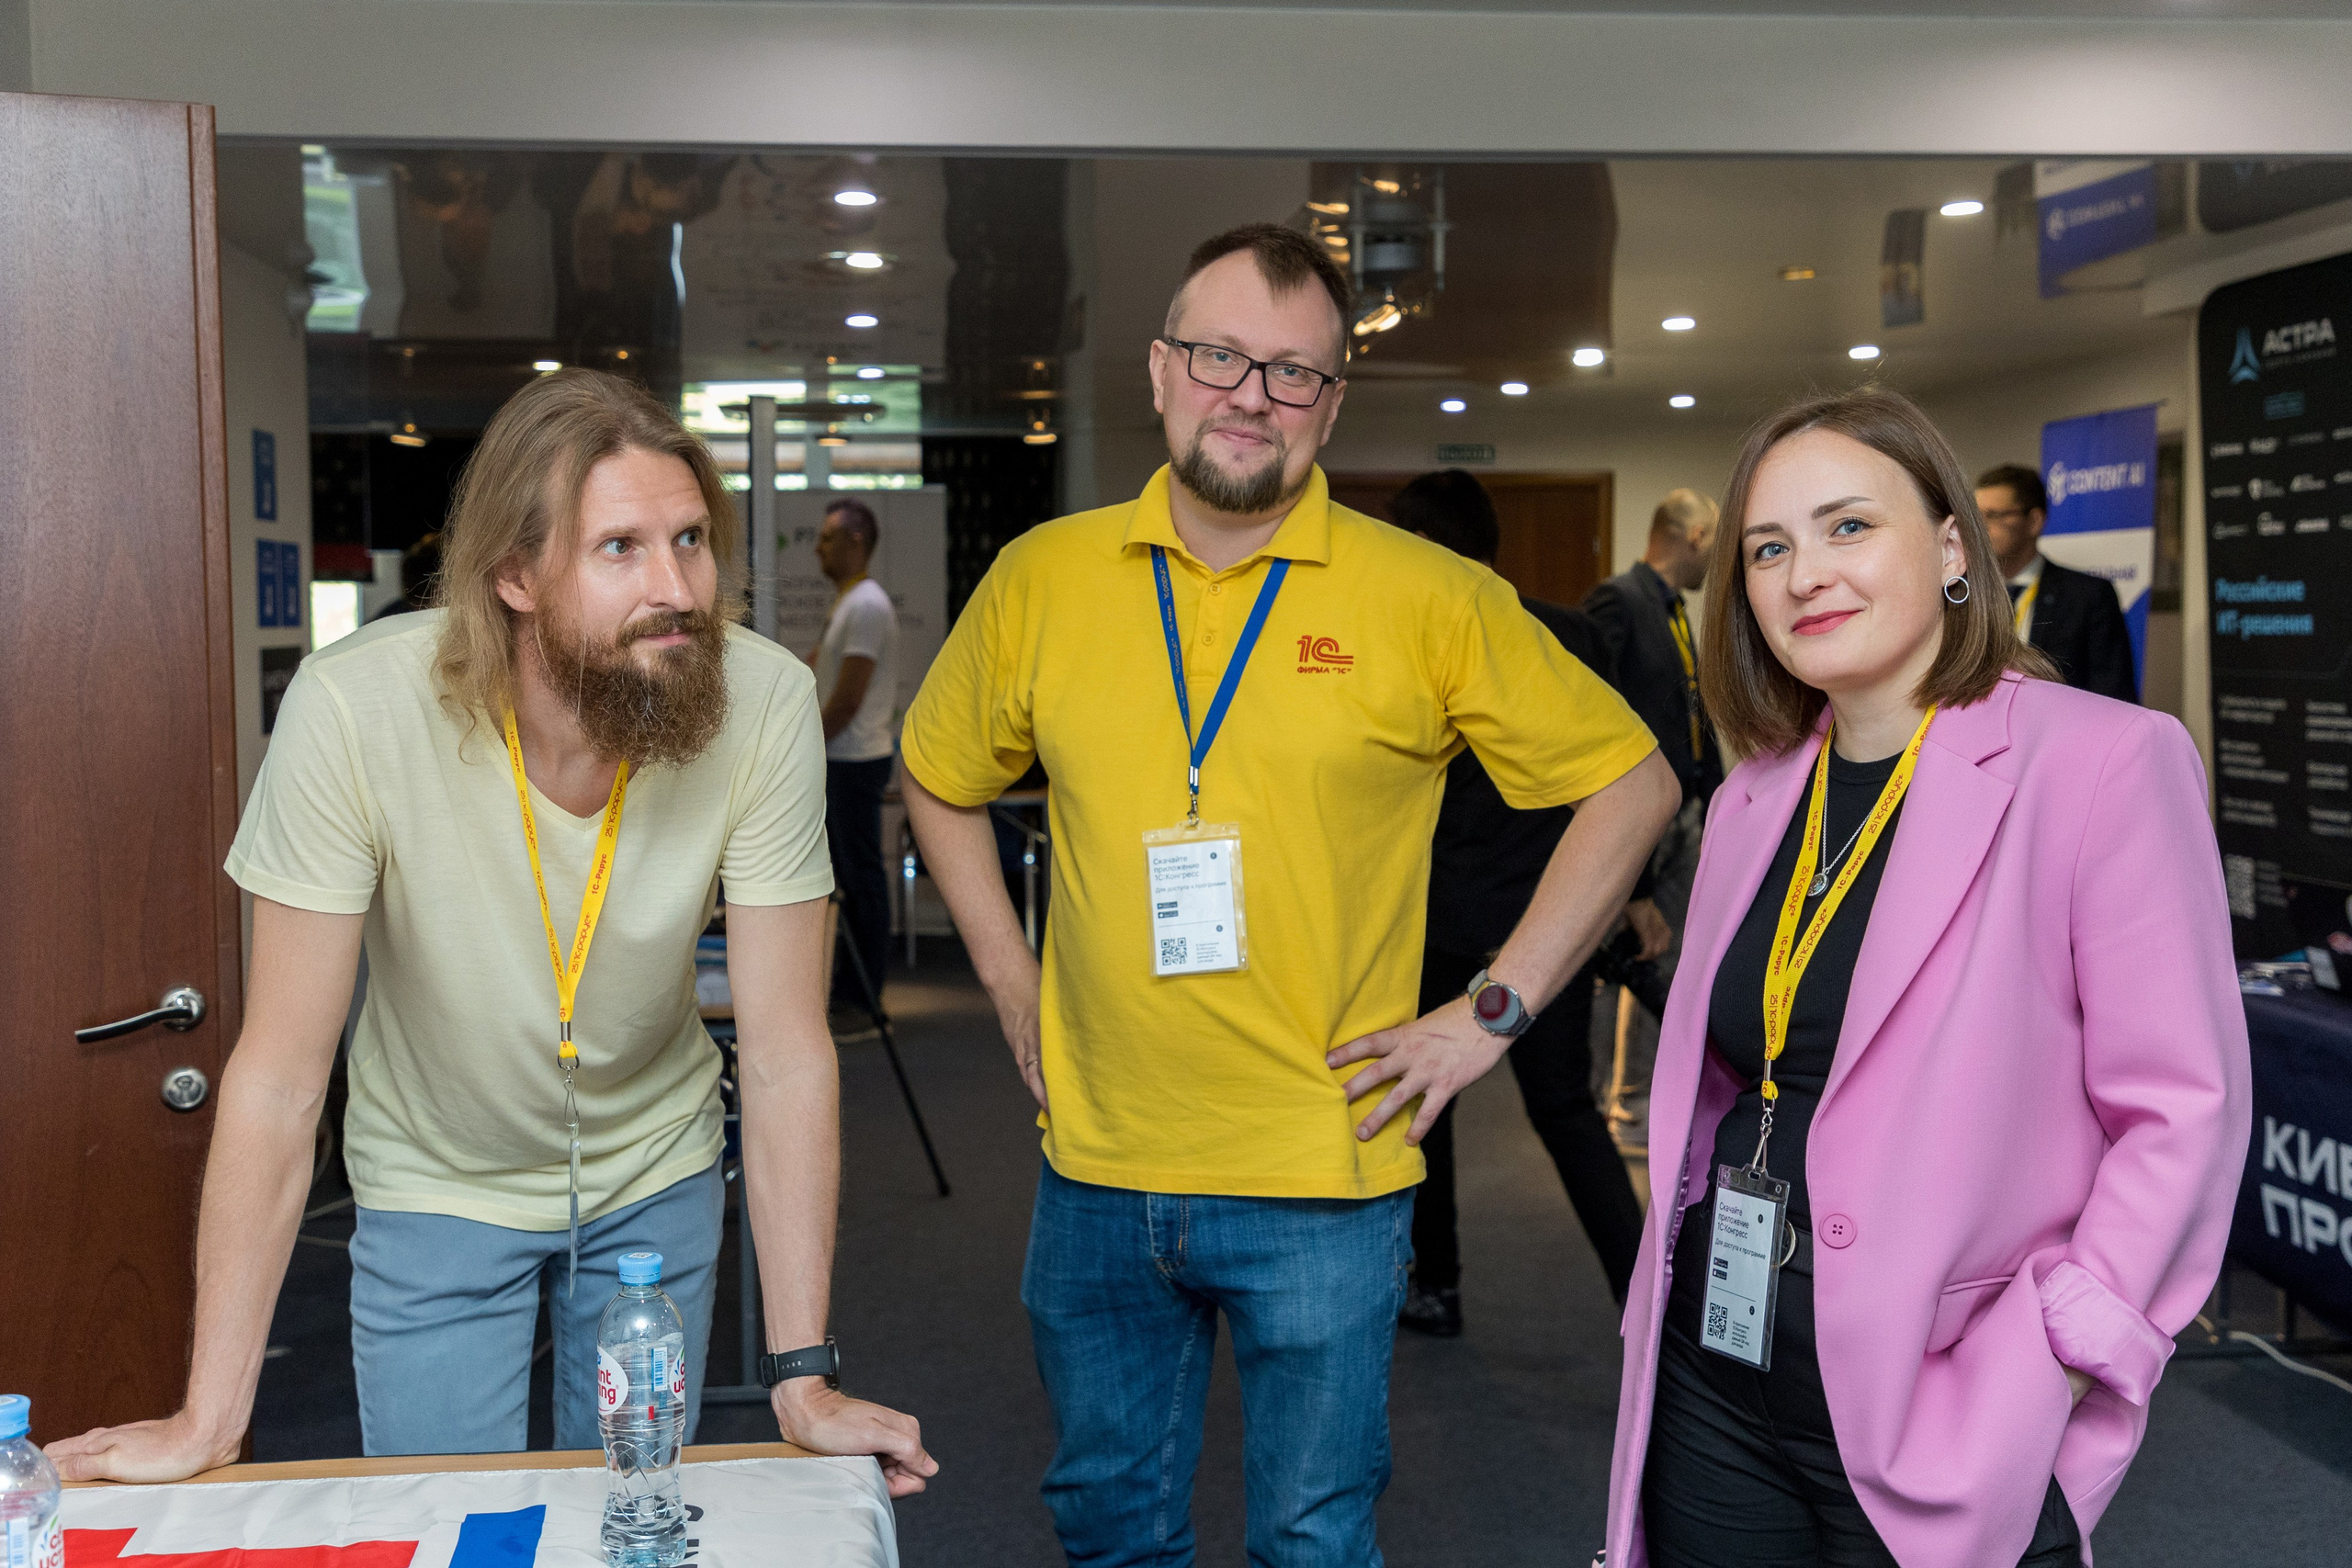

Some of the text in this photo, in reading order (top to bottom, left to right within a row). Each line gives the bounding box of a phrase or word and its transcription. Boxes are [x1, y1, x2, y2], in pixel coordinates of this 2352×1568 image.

[2261, 318, 2335, 356] АСТРА
[1296, 635, 1354, 665] 1С
[1296, 666, 1330, 674] ФИРМА
[1152, 855, 1188, 865] Скачайте
[1153, 863, 1200, 874] приложение
[1154, 871, 1200, 882] 1С:Конгресс
[1719, 1201, 1743, 1217] Скачайте
[1718, 1213, 1749, 1229] приложение
[1717, 1222, 1748, 1239] 1С:Конгресс
